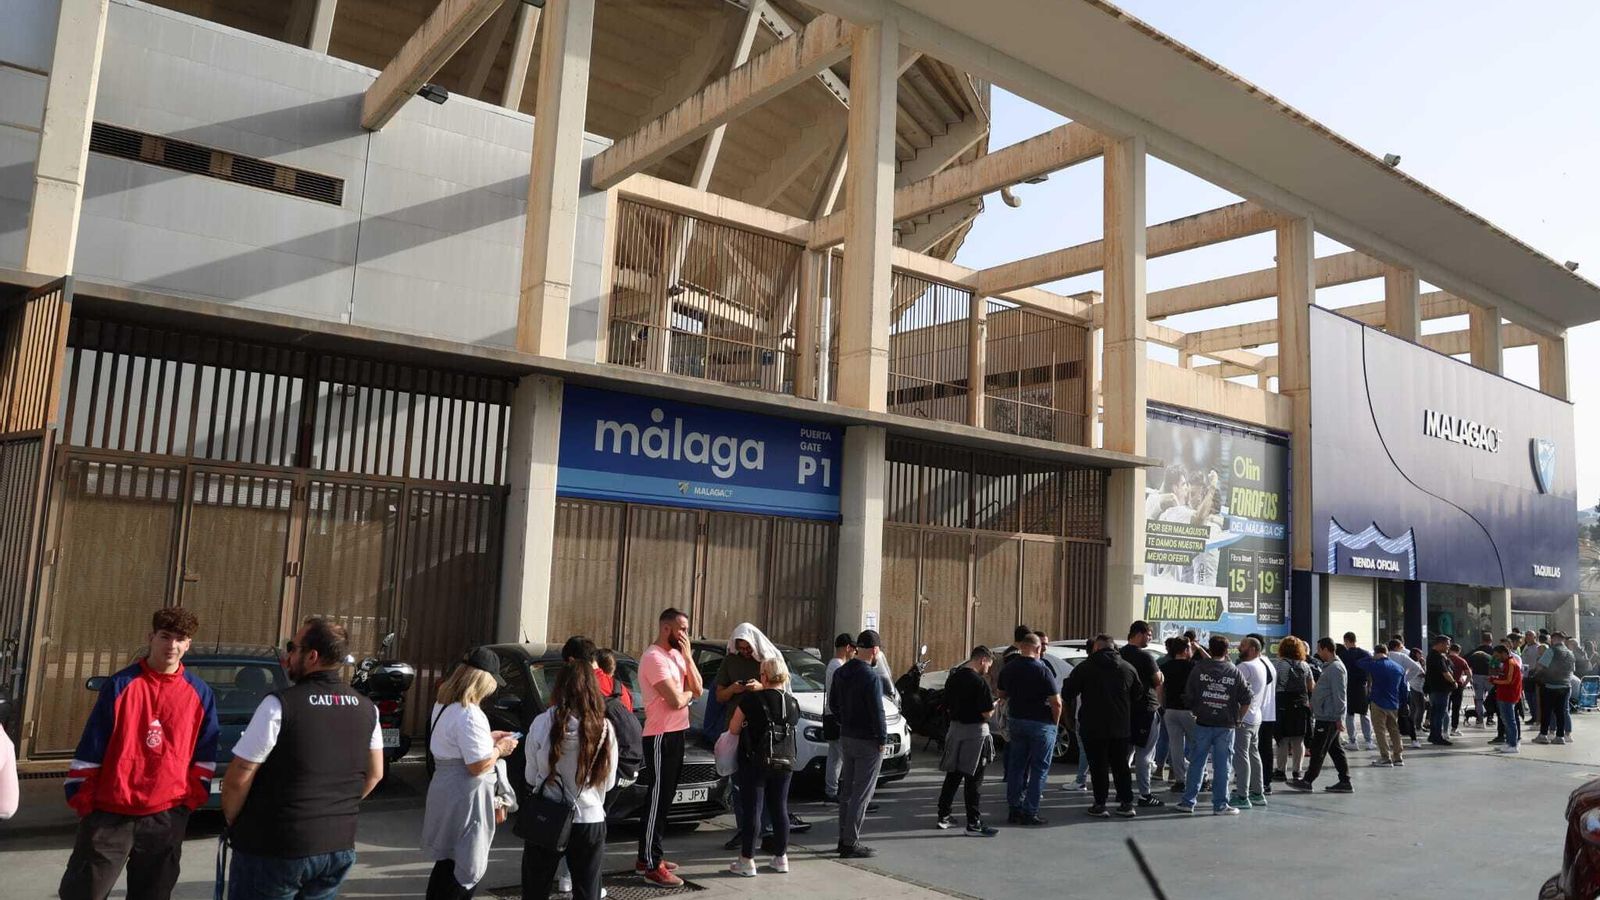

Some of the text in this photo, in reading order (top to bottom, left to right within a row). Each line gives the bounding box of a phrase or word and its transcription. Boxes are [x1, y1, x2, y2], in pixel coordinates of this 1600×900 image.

[800, 428, 832, 441] PUERTA
[800, 441, 822, 452] GATE
[798, 455, 831, 488] P1
[1233, 455, 1260, 481] Olin
[1230, 486, 1279, 520] FOROFOS
[1147, 522, 1160, 531] POR
[1161, 524, 1173, 532] SER
[1231, 521, 1244, 533] DEL
[1274, 526, 1284, 537] CF
[1148, 537, 1203, 551] TE DAMOS NUESTRA
[1147, 551, 1190, 563] MEJOR OFERTA
[1352, 556, 1400, 572] TIENDA OFICIAL
[1532, 564, 1561, 578] TAQUILLAS
[1229, 568, 1246, 593] 15
[1258, 570, 1275, 594] 19
[1160, 596, 1180, 619] POR
[1180, 597, 1218, 620] USTEDES!
[309, 694, 359, 706] CAUTIVO
[688, 789, 706, 801] JPX
